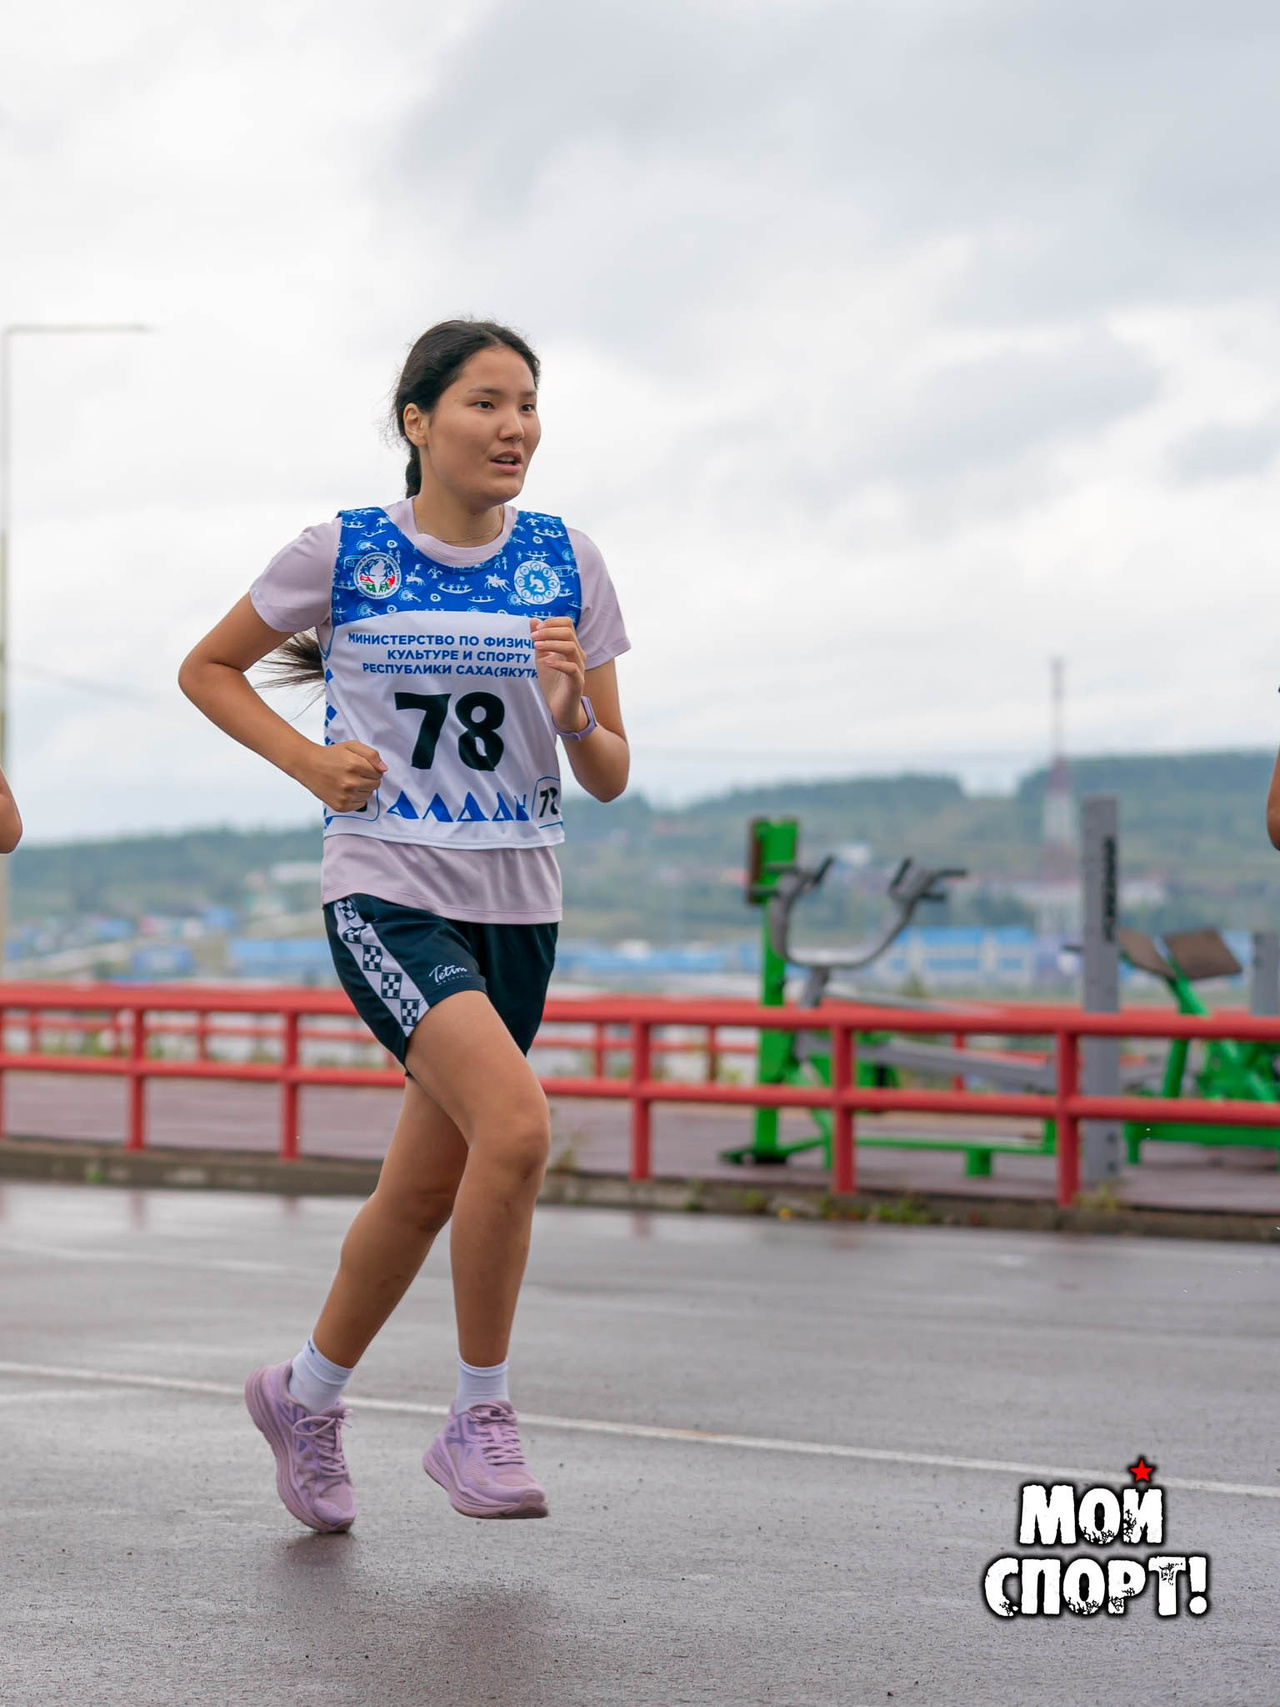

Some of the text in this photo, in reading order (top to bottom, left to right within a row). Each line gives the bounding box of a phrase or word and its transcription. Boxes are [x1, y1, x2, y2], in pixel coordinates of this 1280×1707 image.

[348, 633, 455, 646] МИНИСТЕРСТВО
[459, 636, 479, 646] ПО
[387, 649, 531, 664] КУЛЬТУРЕ И СПОРТУ
[362, 663, 452, 675] РЕСПУБЛИКИ
[394, 691, 505, 772] 78
